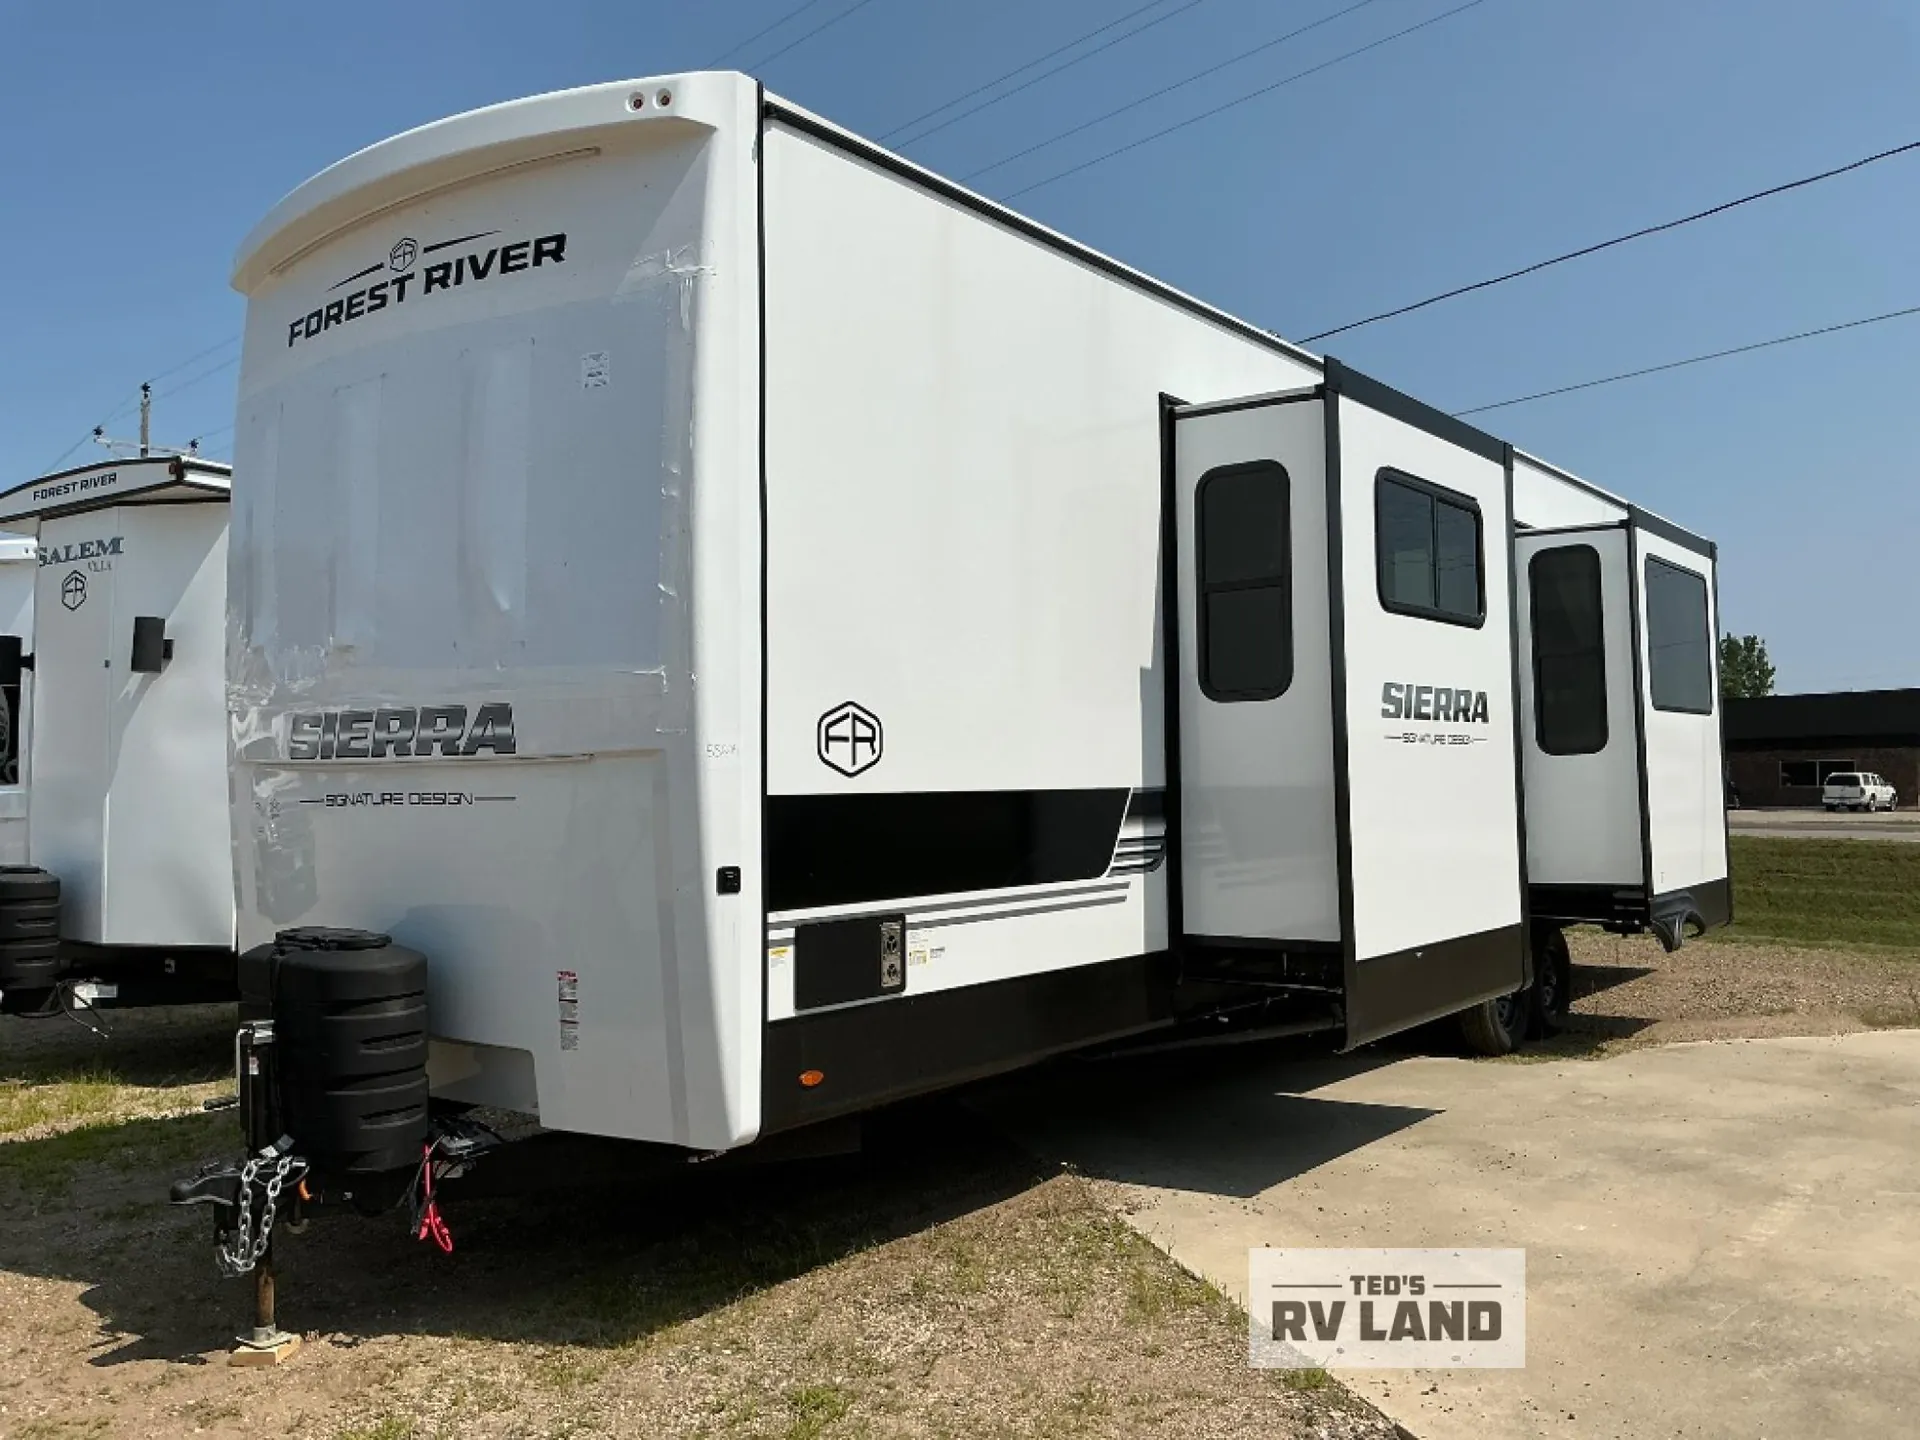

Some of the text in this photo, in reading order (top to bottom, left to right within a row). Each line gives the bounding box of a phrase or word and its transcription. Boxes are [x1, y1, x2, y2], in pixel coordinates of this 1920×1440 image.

[288, 232, 567, 348] FOREST RIVER
[33, 472, 117, 501] FOREST RIVER
[37, 536, 125, 568] SALEM
[1381, 682, 1490, 724] SIERRA
[290, 702, 517, 760] SIERRA
[325, 792, 473, 806] SIGNATURE DESIGN
